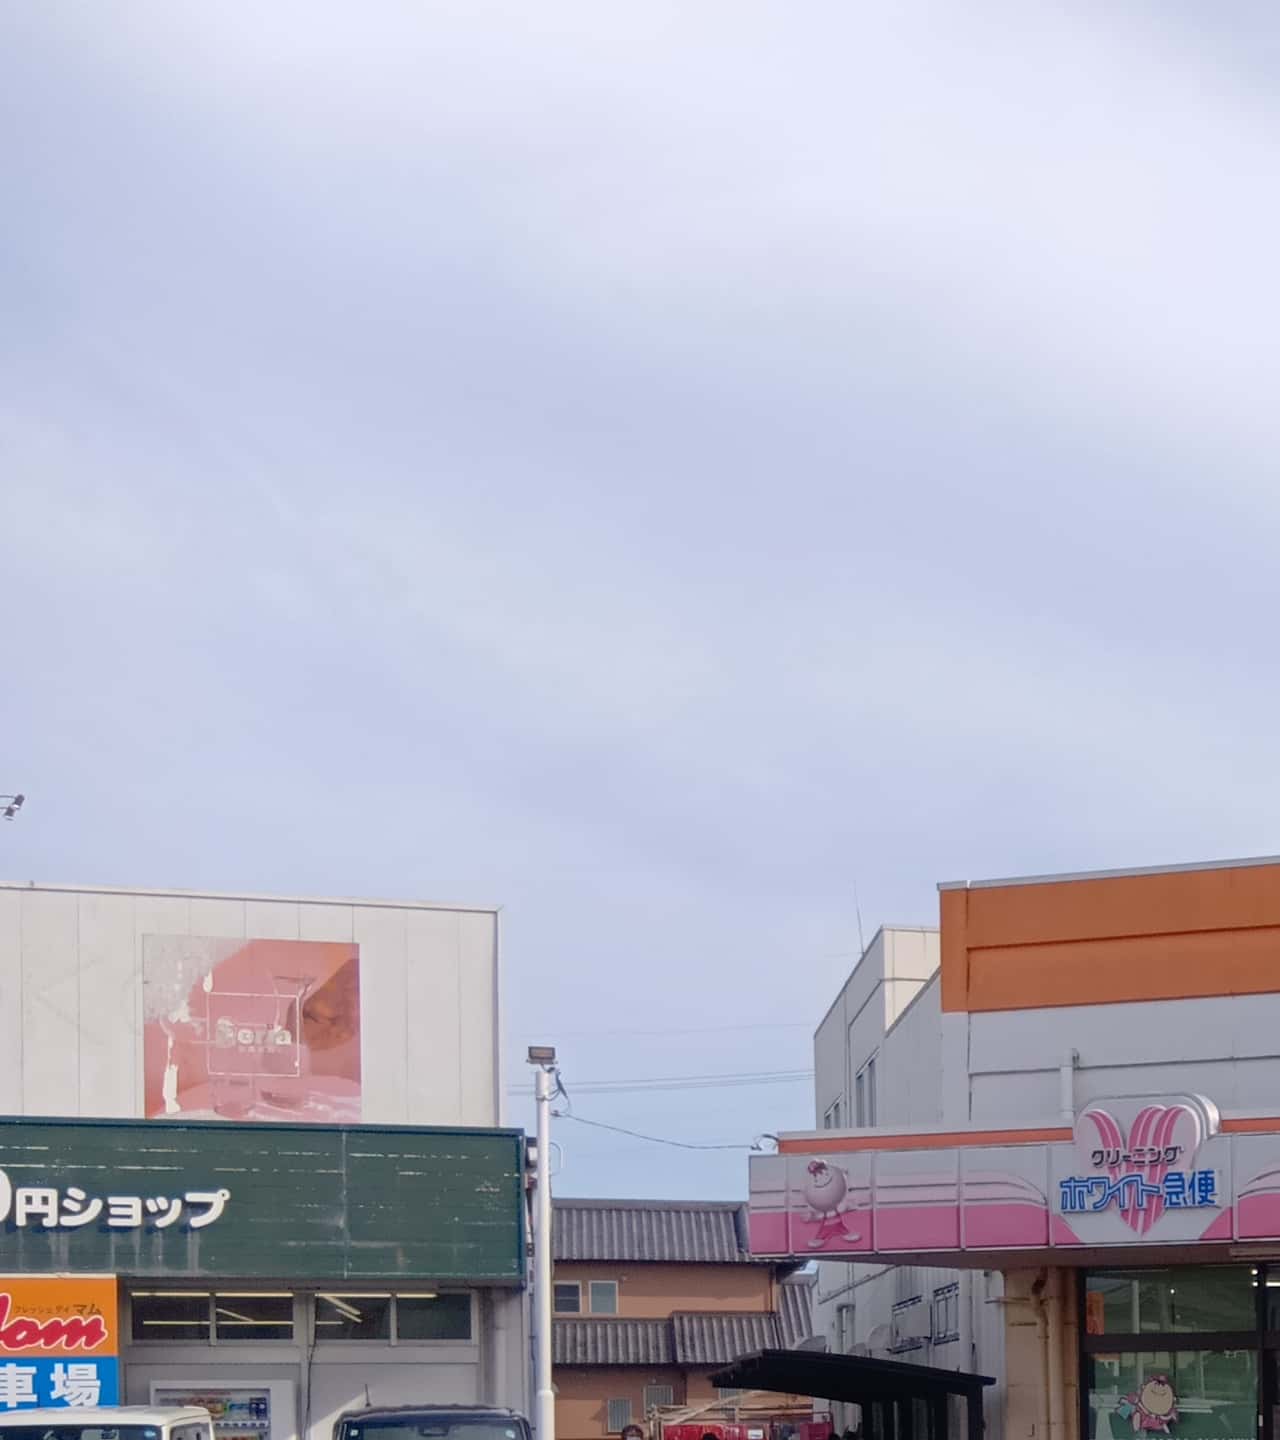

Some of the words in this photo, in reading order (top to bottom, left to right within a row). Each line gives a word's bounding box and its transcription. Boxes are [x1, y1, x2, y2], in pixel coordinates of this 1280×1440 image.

[1091, 1145, 1184, 1166] クリーニング
[1059, 1169, 1216, 1210] ホワイト急便
